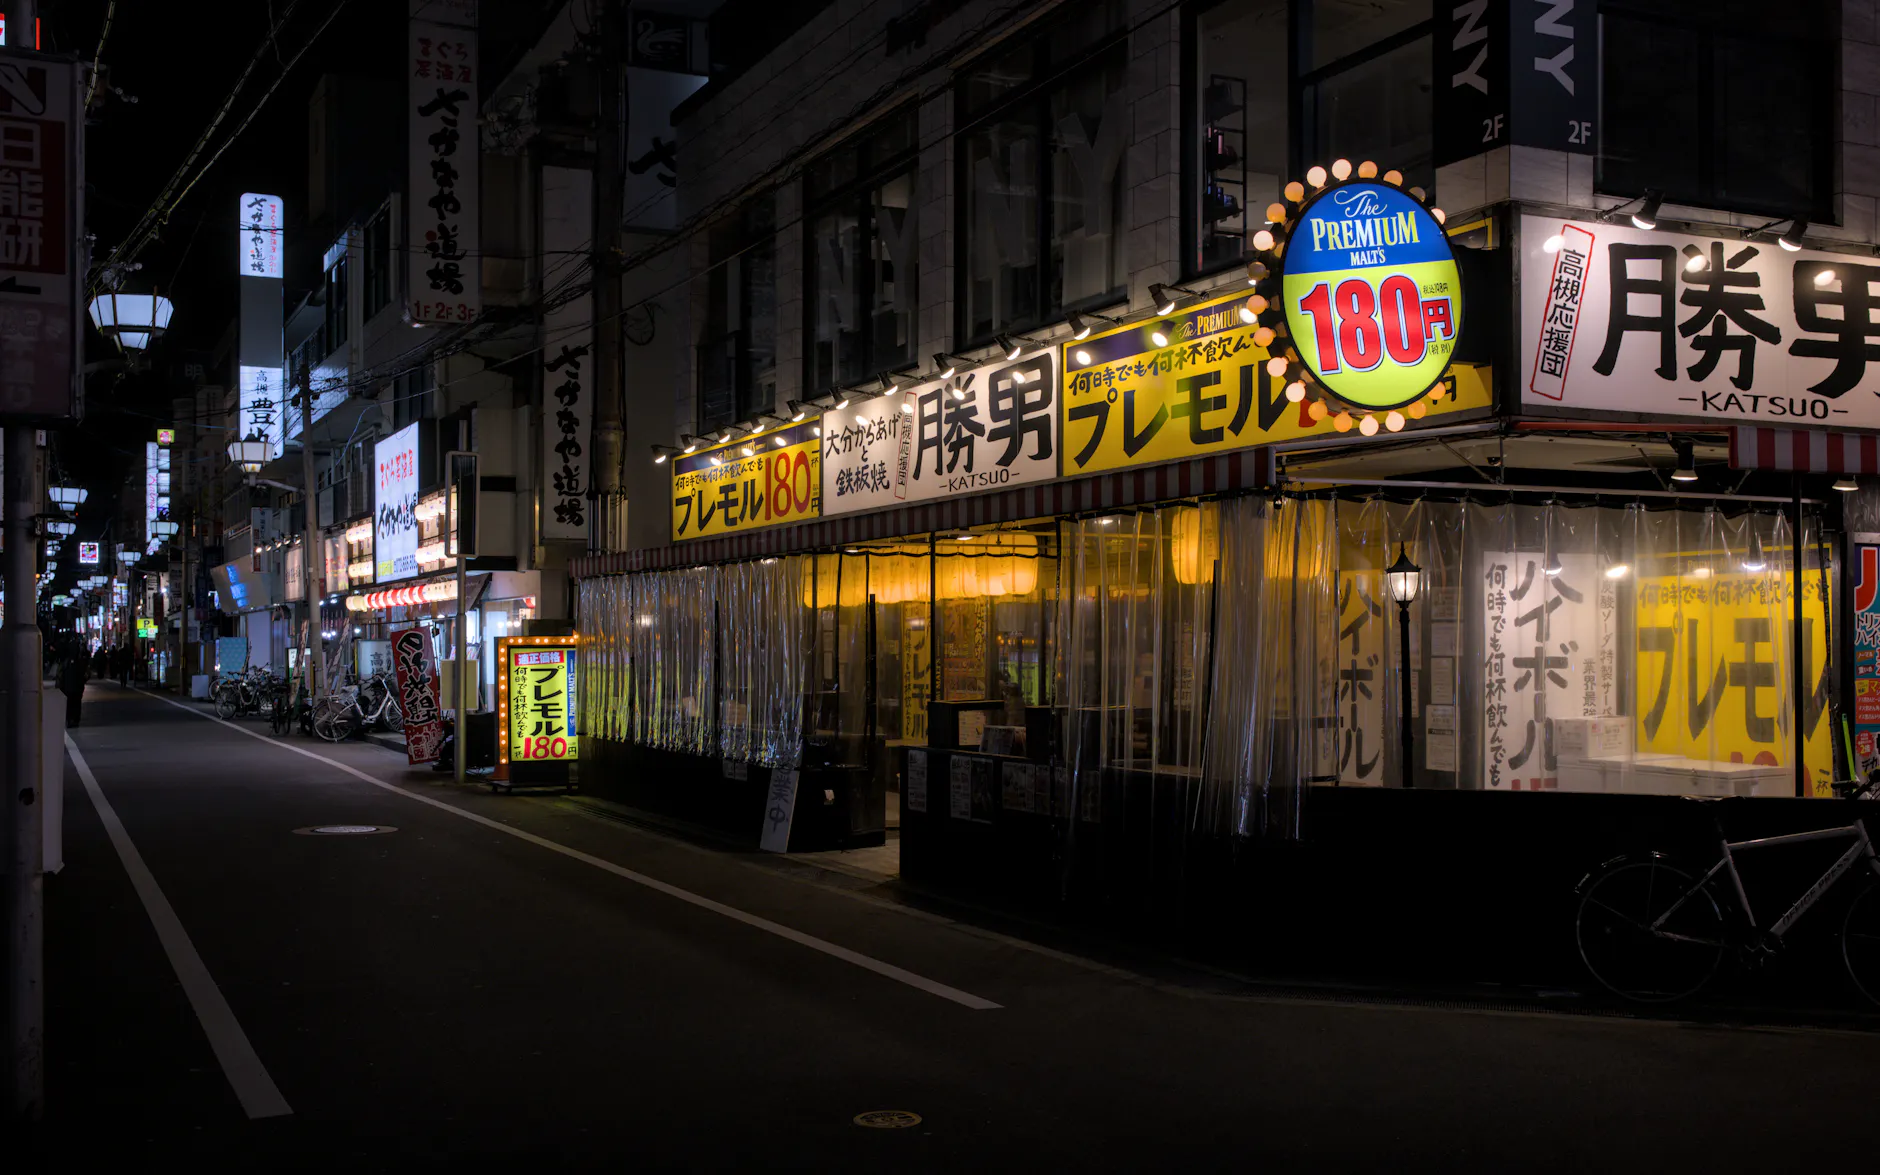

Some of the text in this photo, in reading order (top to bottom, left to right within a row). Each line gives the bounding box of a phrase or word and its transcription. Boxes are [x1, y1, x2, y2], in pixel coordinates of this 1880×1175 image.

[418, 38, 468, 60] まぐろ
[415, 60, 473, 83] 居酒屋
[1482, 114, 1504, 142] 2F
[1568, 120, 1592, 144] 2F
[418, 88, 468, 294] さかなや道場
[1334, 190, 1388, 217] The
[1310, 211, 1420, 252] PREMIUM
[1350, 249, 1386, 267] MALT'S
[414, 302, 475, 321] 1F 2F 3F
[1541, 248, 1585, 379] 高槻応援団
[1592, 241, 1880, 399] 勝男
[912, 352, 1053, 481] 勝男
[1068, 358, 1290, 469] プレモル
[546, 345, 588, 527] さかなや道場
[825, 412, 902, 460] 大分からあげ
[861, 445, 868, 463] と
[675, 457, 763, 491] 何時でも何杯飲んでも
[836, 460, 890, 496] 鉄板焼
[675, 478, 764, 536] プレモル
[518, 652, 561, 665] 適正価格
[1855, 629, 1880, 647] ハイ
[1341, 578, 1381, 779] ハイボール
[1485, 562, 1508, 787] 何時でも何杯飲んでも
[1508, 560, 1583, 771] ハイボール
[1639, 612, 1832, 743] プレモル
[513, 667, 527, 738] 何時でも何杯飲んでも
[530, 665, 564, 736] プレモル
[1816, 769, 1830, 795] 一杯
